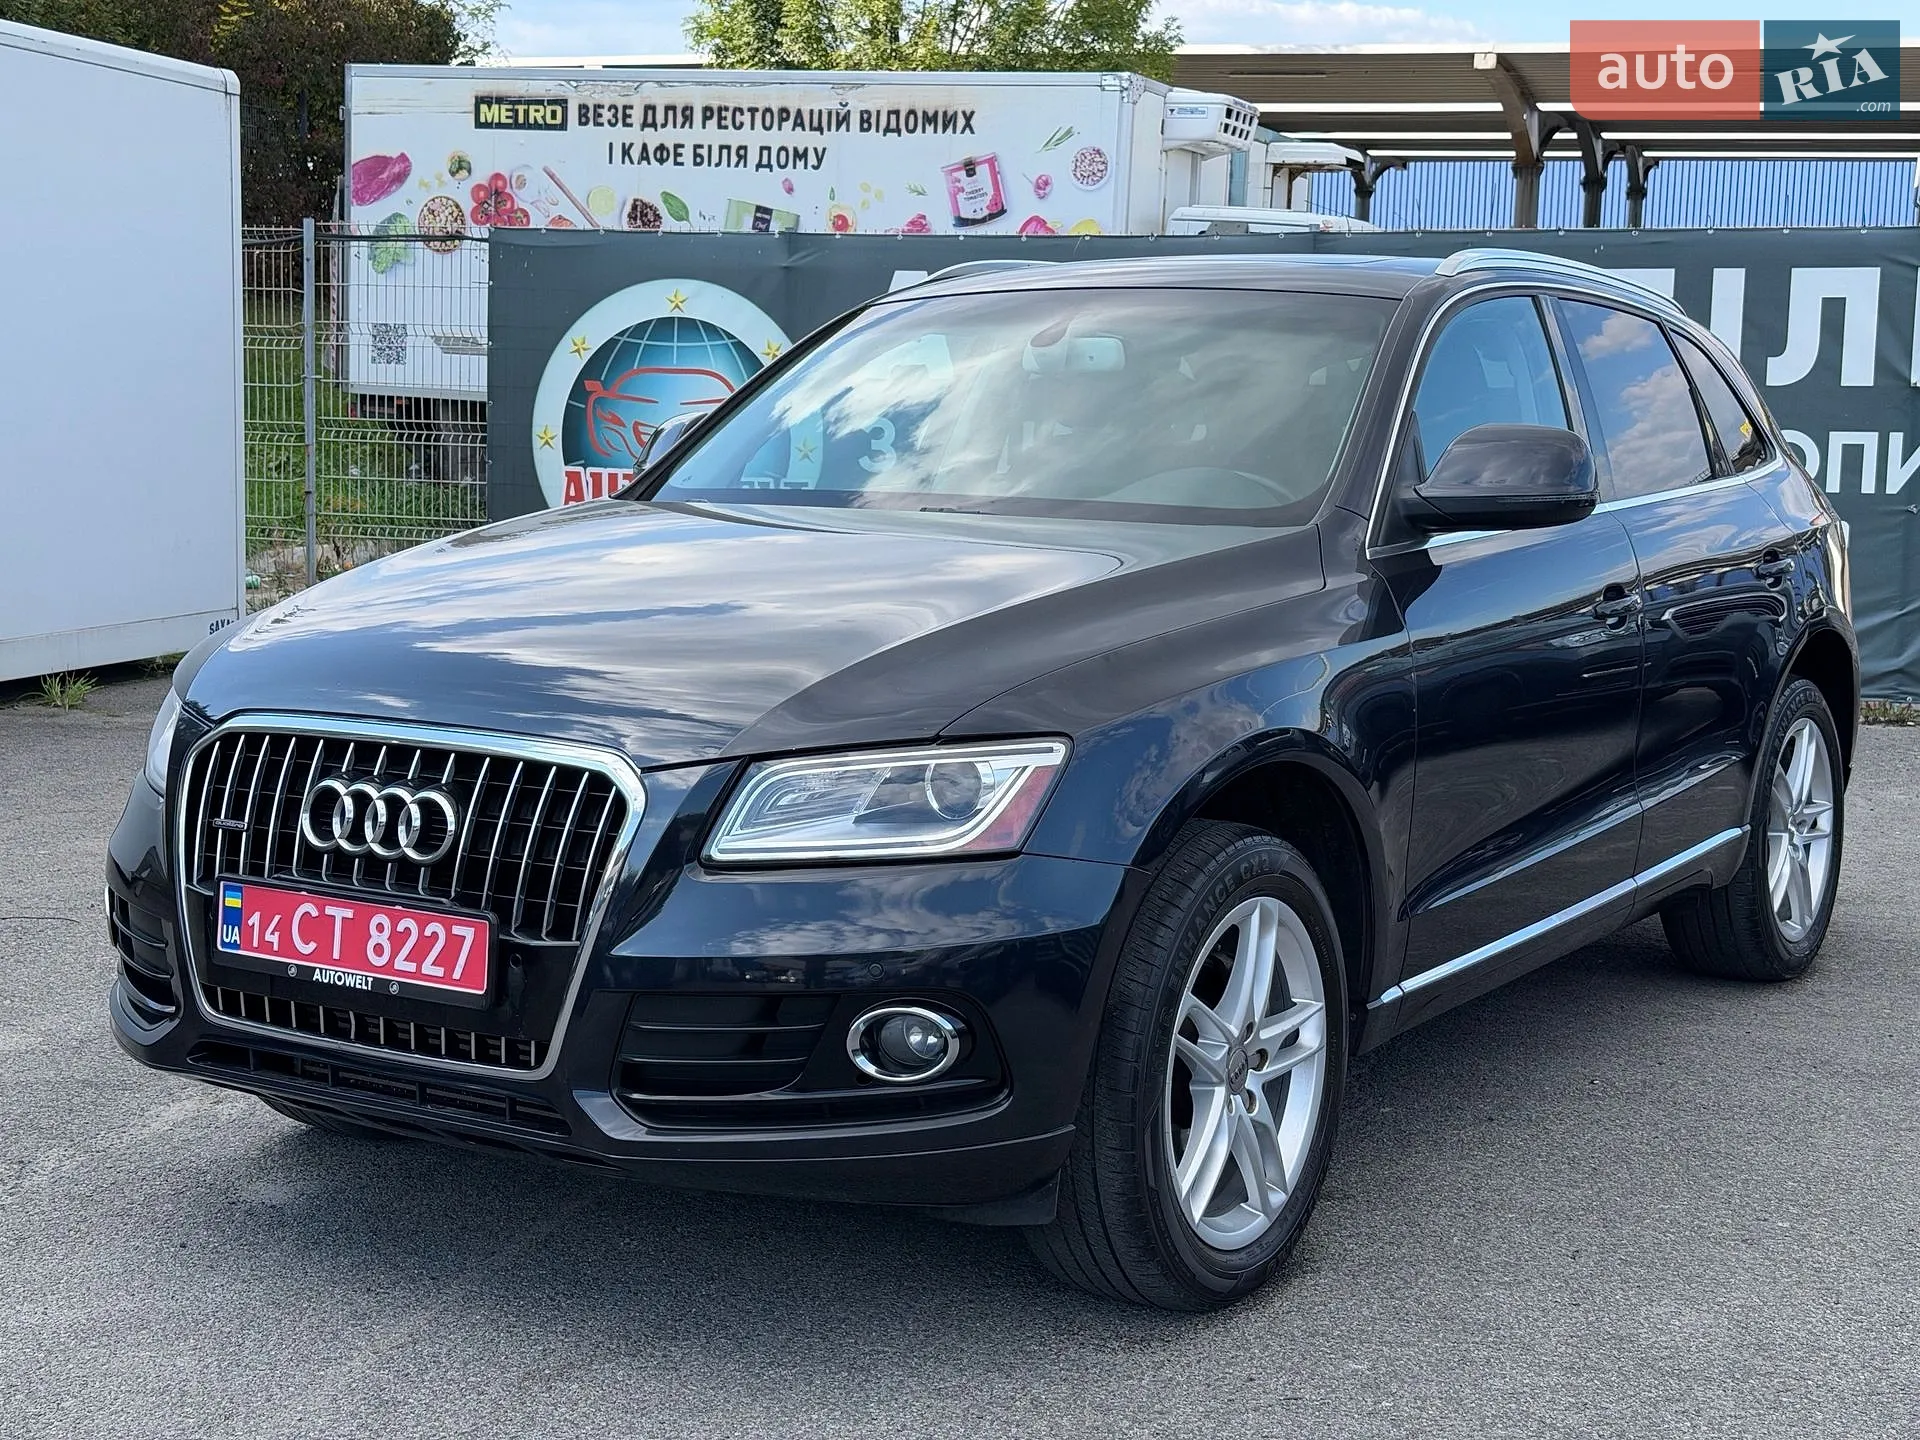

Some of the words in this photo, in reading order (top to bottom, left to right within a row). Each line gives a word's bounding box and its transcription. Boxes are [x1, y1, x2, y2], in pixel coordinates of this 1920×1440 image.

[479, 103, 563, 126] METRO
[577, 102, 634, 129] ВЕЗЕ
[640, 104, 694, 132] ДЛЯ
[701, 101, 851, 136] РЕСТОРАЦІЙ
[858, 109, 976, 136] ВІДОМИХ
[608, 142, 614, 165] І
[621, 143, 685, 168] КАФЕ
[693, 144, 748, 168] БІЛЯ
[755, 145, 827, 172] ДОМУ
[222, 925, 241, 945] UA
[247, 911, 282, 951] 14
[366, 913, 476, 981] 8227
[312, 967, 374, 991] AUTOWELT
